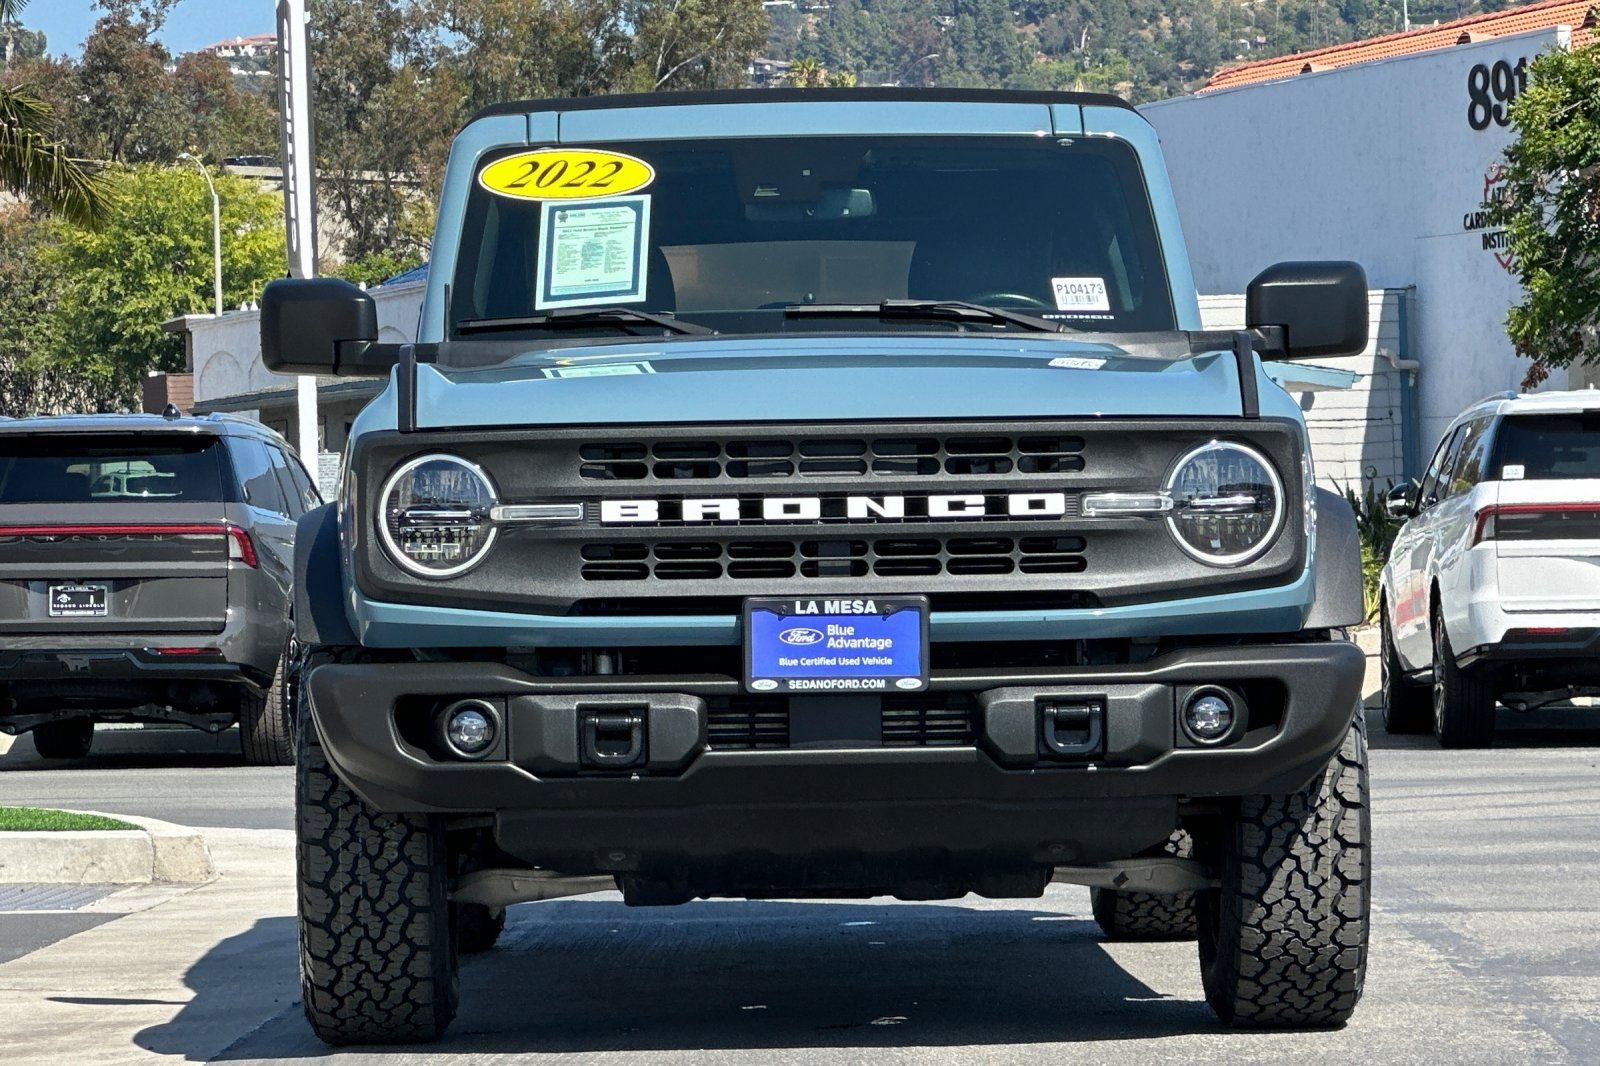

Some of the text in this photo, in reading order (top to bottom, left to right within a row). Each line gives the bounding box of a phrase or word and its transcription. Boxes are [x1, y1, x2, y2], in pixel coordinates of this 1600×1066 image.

[503, 159, 625, 189] 2022
[1056, 283, 1104, 295] P104173
[600, 492, 1067, 522] BRONCO
[795, 600, 877, 614] LA MESA
[827, 624, 855, 636] Blue
[826, 635, 893, 650] Advantage
[779, 656, 893, 666] Blue Certified Used Vehicle
[788, 678, 886, 690] SEDANOFORD.COM
